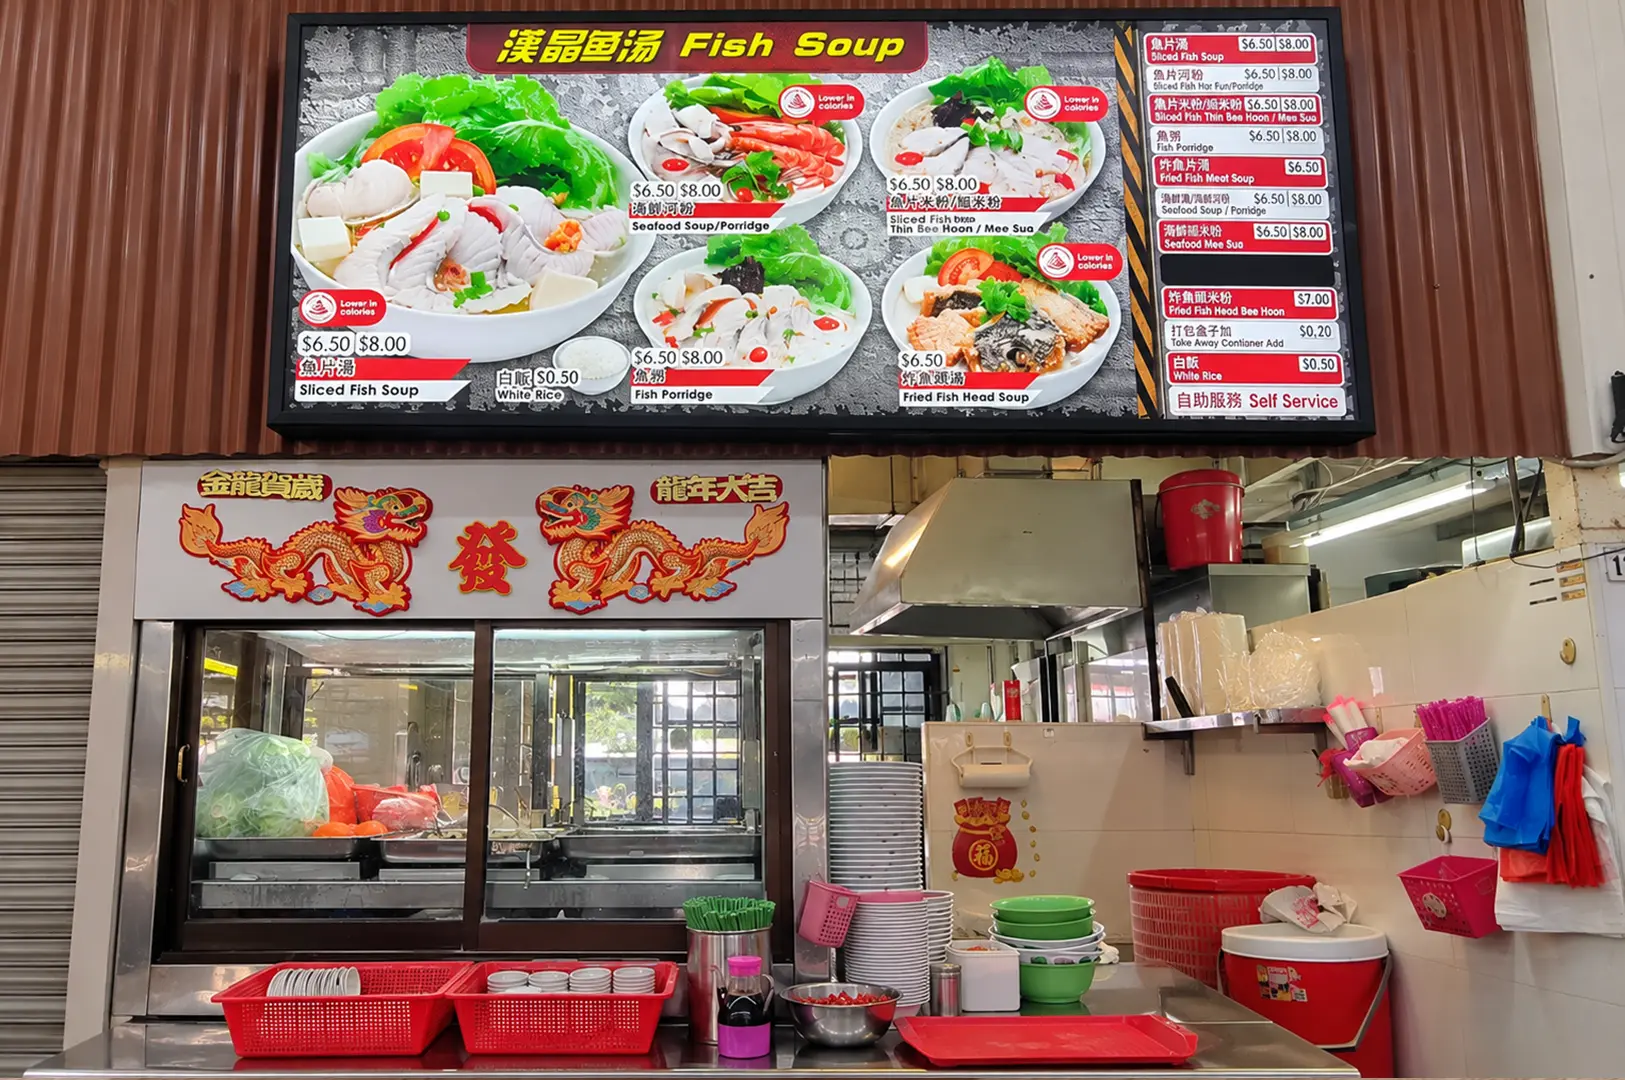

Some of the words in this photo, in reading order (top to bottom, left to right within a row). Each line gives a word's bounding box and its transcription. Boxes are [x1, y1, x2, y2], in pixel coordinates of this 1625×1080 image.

[679, 32, 774, 58] Fish
[794, 32, 905, 62] Soup
[1242, 38, 1272, 50] $6.50
[1279, 38, 1309, 50] $8.00
[1151, 52, 1178, 61] Sliced
[1181, 52, 1198, 61] Fish
[1201, 52, 1224, 62] Soup
[1244, 68, 1276, 80] $6.50
[1282, 68, 1312, 80] $8.00
[1154, 82, 1178, 90] Sliced
[1180, 82, 1196, 90] Fish
[818, 94, 845, 102] Lower
[847, 94, 855, 102] in
[1091, 95, 1100, 103] in
[818, 102, 853, 110] calories
[1064, 103, 1100, 112] calories
[1247, 99, 1278, 110] $6.50
[1283, 99, 1314, 111] $8.00
[1155, 112, 1182, 121] Sliced
[1185, 112, 1202, 121] Fish
[1204, 112, 1224, 121] Thin
[1226, 113, 1243, 122] Bee
[1246, 113, 1269, 122] Hoon
[1278, 114, 1297, 122] Mee
[1300, 114, 1317, 122] Sua
[1249, 130, 1280, 142] $6.50
[1286, 130, 1317, 142] $8.00
[1157, 143, 1174, 151] Fish
[1176, 143, 1213, 153] Porridge
[1288, 161, 1319, 173] $6.50
[890, 177, 931, 191] $6.50
[936, 177, 977, 191] $8.00
[1160, 173, 1182, 182] Fried
[1185, 173, 1203, 182] Fish
[1205, 173, 1229, 182] Meat
[1231, 173, 1255, 185] Soup
[633, 183, 675, 198] $6.50
[680, 183, 721, 198] $8.00
[1254, 193, 1284, 205] $6.50
[1291, 193, 1322, 205] $8.00
[1162, 206, 1198, 215] Seafood
[1200, 206, 1223, 216] Soup
[1230, 206, 1267, 216] Porridge
[890, 215, 926, 224] Sliced
[930, 215, 951, 224] Fish
[632, 221, 680, 231] Seafood
[685, 221, 770, 232] Soup/Porridge
[891, 224, 913, 233] Thin
[917, 224, 939, 233] Bee
[943, 224, 973, 233] Hoon
[984, 224, 1009, 233] Mee
[1013, 224, 1034, 233] Sua
[1257, 226, 1287, 238] $6.50
[1293, 226, 1324, 238] $8.00
[1164, 239, 1202, 249] Seafood
[1204, 239, 1224, 249] Mee
[1226, 239, 1244, 249] Sua
[1077, 253, 1101, 261] Lower
[1077, 261, 1113, 270] calories
[368, 299, 378, 307] in
[1298, 293, 1330, 305] $7.00
[340, 308, 376, 316] calories
[1169, 306, 1192, 315] Fried
[1194, 306, 1212, 315] Fish
[1214, 306, 1238, 316] Head
[1241, 306, 1259, 316] Bee
[1261, 306, 1285, 316] Hoon
[1171, 325, 1232, 337] 打包盒子加
[1300, 325, 1332, 338] $0.20
[302, 335, 350, 352] $6.50
[359, 335, 406, 352] $8.00
[1171, 338, 1193, 347] Take
[1194, 338, 1219, 348] Away
[1266, 338, 1284, 348] Add
[634, 350, 677, 364] $6.50
[682, 350, 723, 364] $8.00
[901, 353, 943, 368] $6.50
[300, 359, 354, 376] 魚片湯
[1302, 358, 1335, 371] $0.50
[1173, 371, 1200, 381] White
[1202, 371, 1222, 381] Rice
[300, 384, 345, 396] Sliced
[350, 384, 376, 396] Fish
[382, 384, 419, 398] Soup
[498, 390, 531, 399] White
[536, 390, 562, 399] Rice
[635, 389, 658, 399] Fish
[662, 389, 713, 401] Porridge
[904, 392, 932, 402] Fried
[937, 392, 959, 402] Fish
[963, 392, 995, 402] Head
[999, 392, 1029, 403] Soup
[1178, 392, 1242, 409] 自助服務
[1249, 393, 1278, 408] Self
[1282, 393, 1338, 409] Service
[656, 473, 779, 503] 龍年大吉
[1612, 554, 1625, 576] 1
